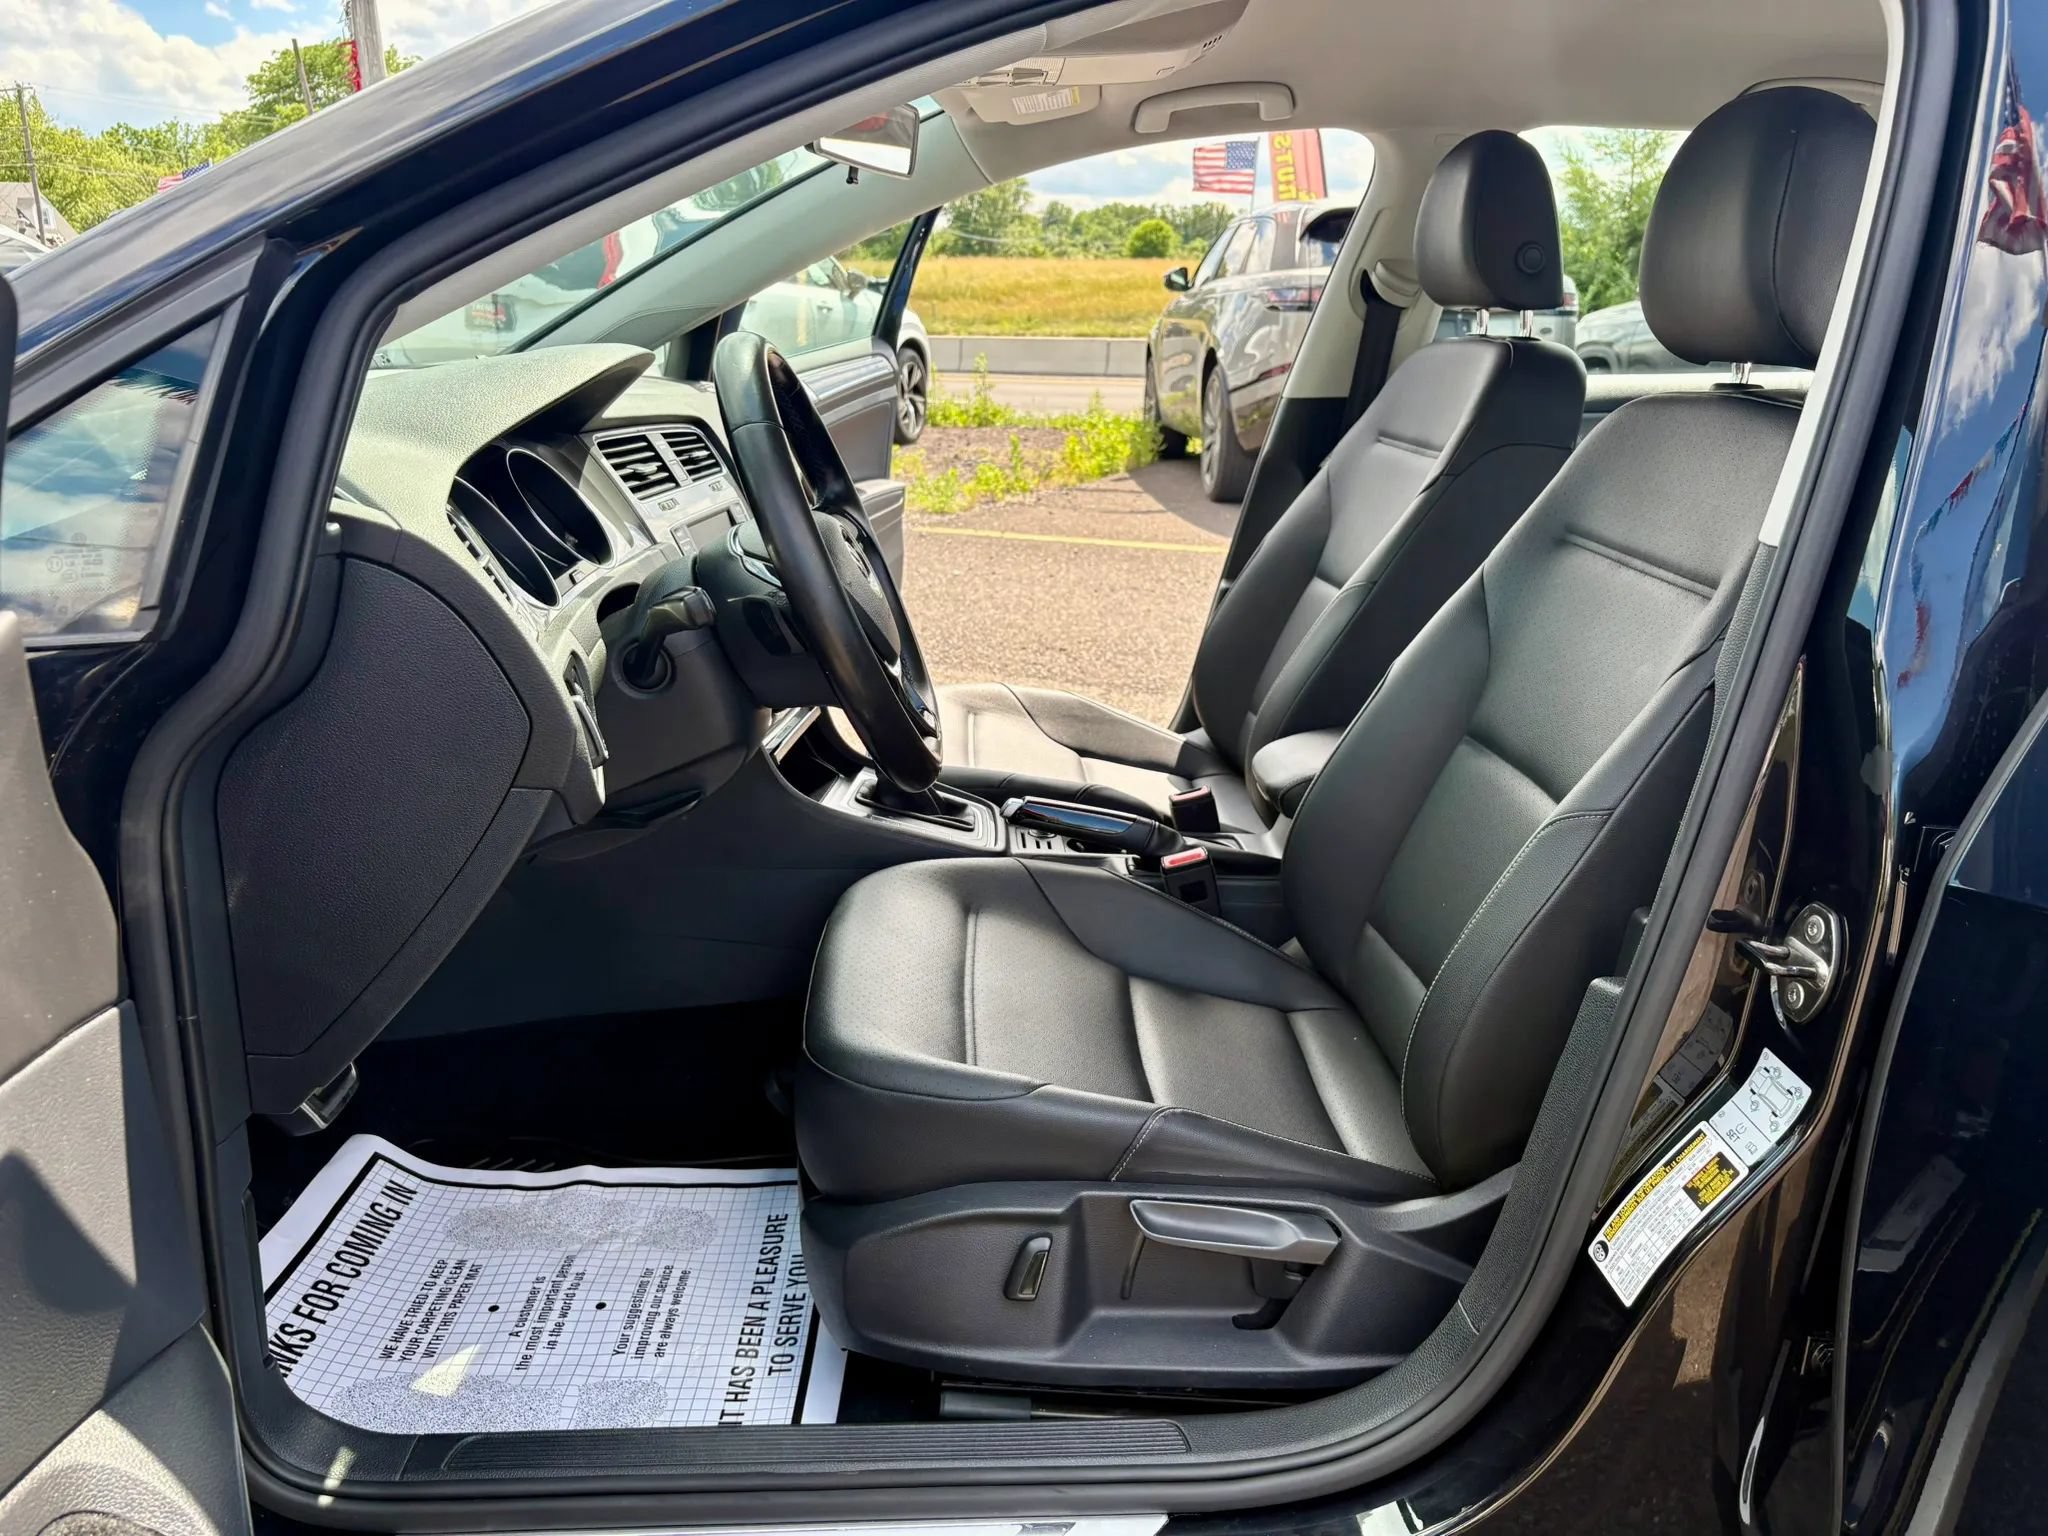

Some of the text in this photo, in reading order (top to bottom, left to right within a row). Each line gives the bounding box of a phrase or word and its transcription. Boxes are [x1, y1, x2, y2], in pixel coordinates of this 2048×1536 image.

[1726, 1128, 1740, 1142] SET
[269, 1180, 418, 1377] NKS FOR COMING IN
[379, 1260, 448, 1359] WE HAVE TRIED TO KEEP
[398, 1260, 468, 1361] YOUR CARPETING CLEAN
[421, 1264, 483, 1359] WITH THIS PAPER MAT
[508, 1330, 522, 1338] A
[515, 1287, 541, 1328] customer
[515, 1255, 577, 1370] the most important person
[543, 1269, 587, 1350] in the world to us.
[611, 1268, 655, 1356] Your suggestions for
[630, 1265, 674, 1359] improving our service
[655, 1267, 692, 1358] are always welcome.
[718, 1213, 788, 1425] IT HAS BEEN A PLEASURE
[774, 1293, 806, 1347] SERVE
[768, 1354, 795, 1376] TO
